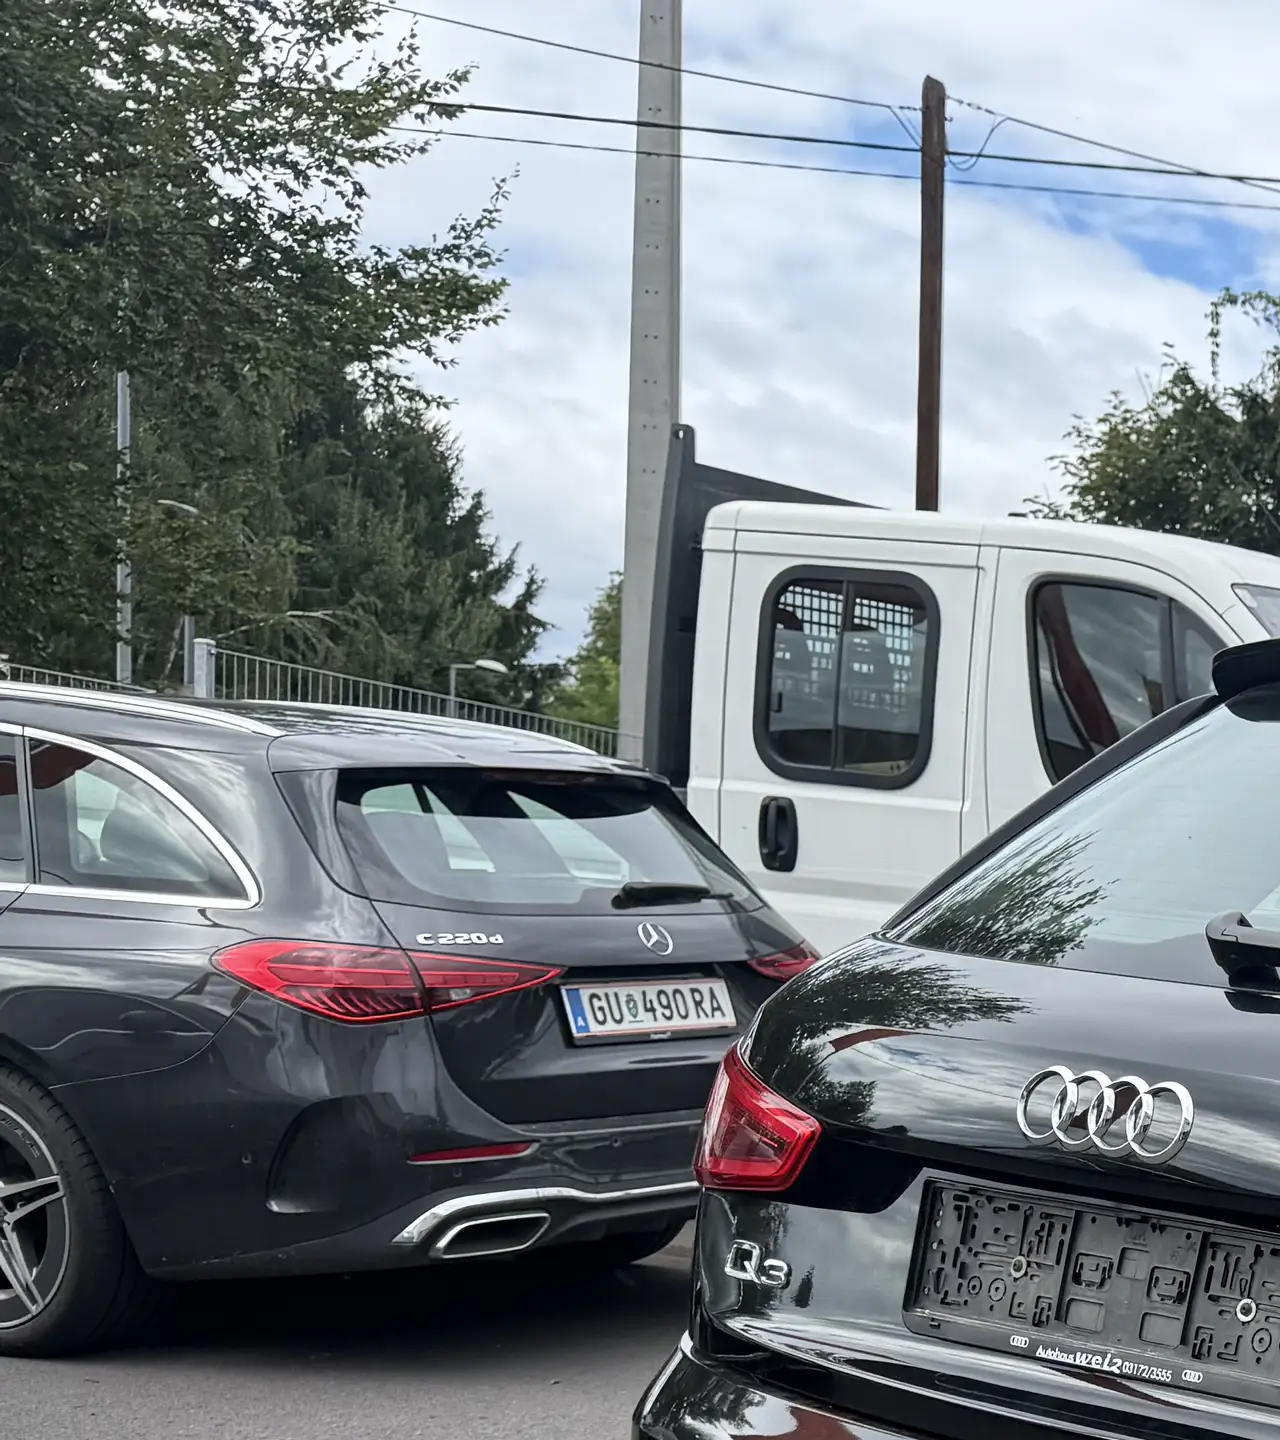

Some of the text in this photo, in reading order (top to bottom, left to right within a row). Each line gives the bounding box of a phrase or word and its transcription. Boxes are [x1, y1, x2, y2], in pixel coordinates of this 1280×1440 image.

[577, 1016, 585, 1028] A
[588, 991, 624, 1026] GU
[724, 1239, 790, 1289] Q3
[1035, 1345, 1076, 1363] Autohaus
[1122, 1361, 1173, 1382] 03172/3555
